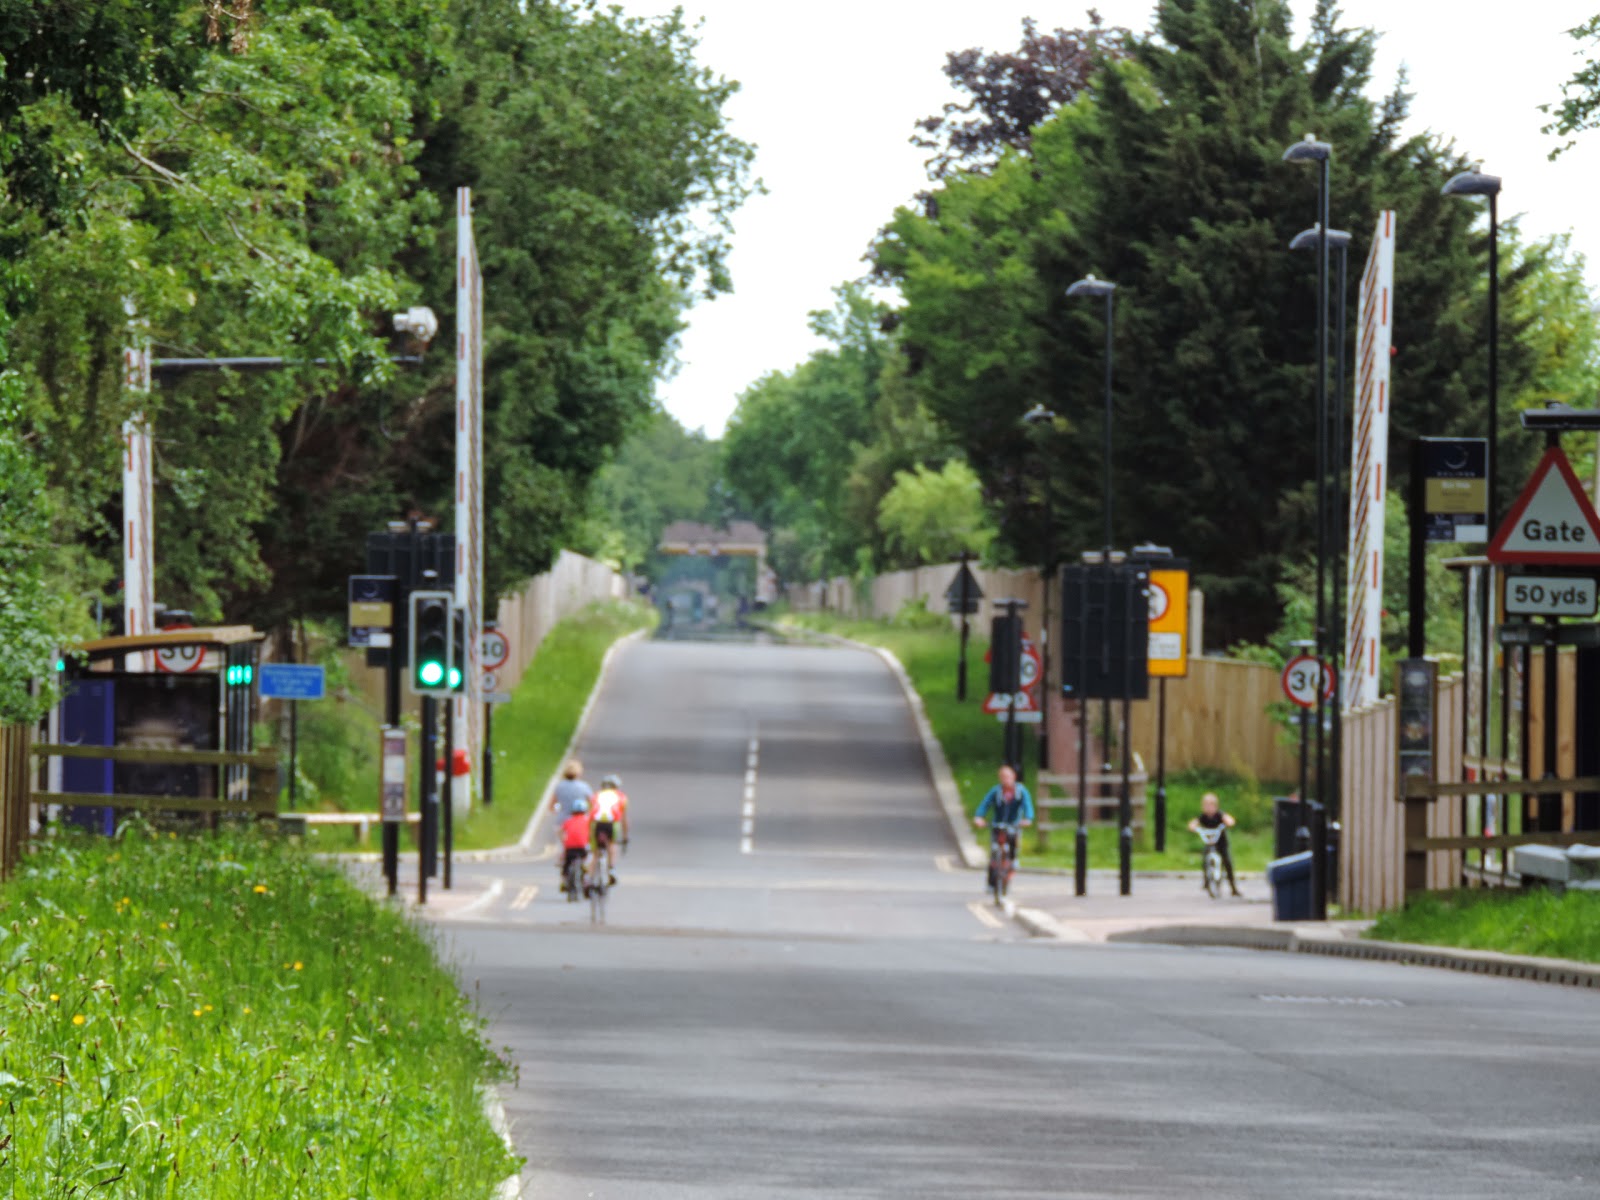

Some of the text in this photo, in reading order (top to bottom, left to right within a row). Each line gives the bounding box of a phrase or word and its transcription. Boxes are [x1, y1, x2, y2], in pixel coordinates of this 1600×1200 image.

[1523, 519, 1585, 542] Gate
[1515, 585, 1587, 607] 50 yds
[1292, 670, 1326, 691] 30
